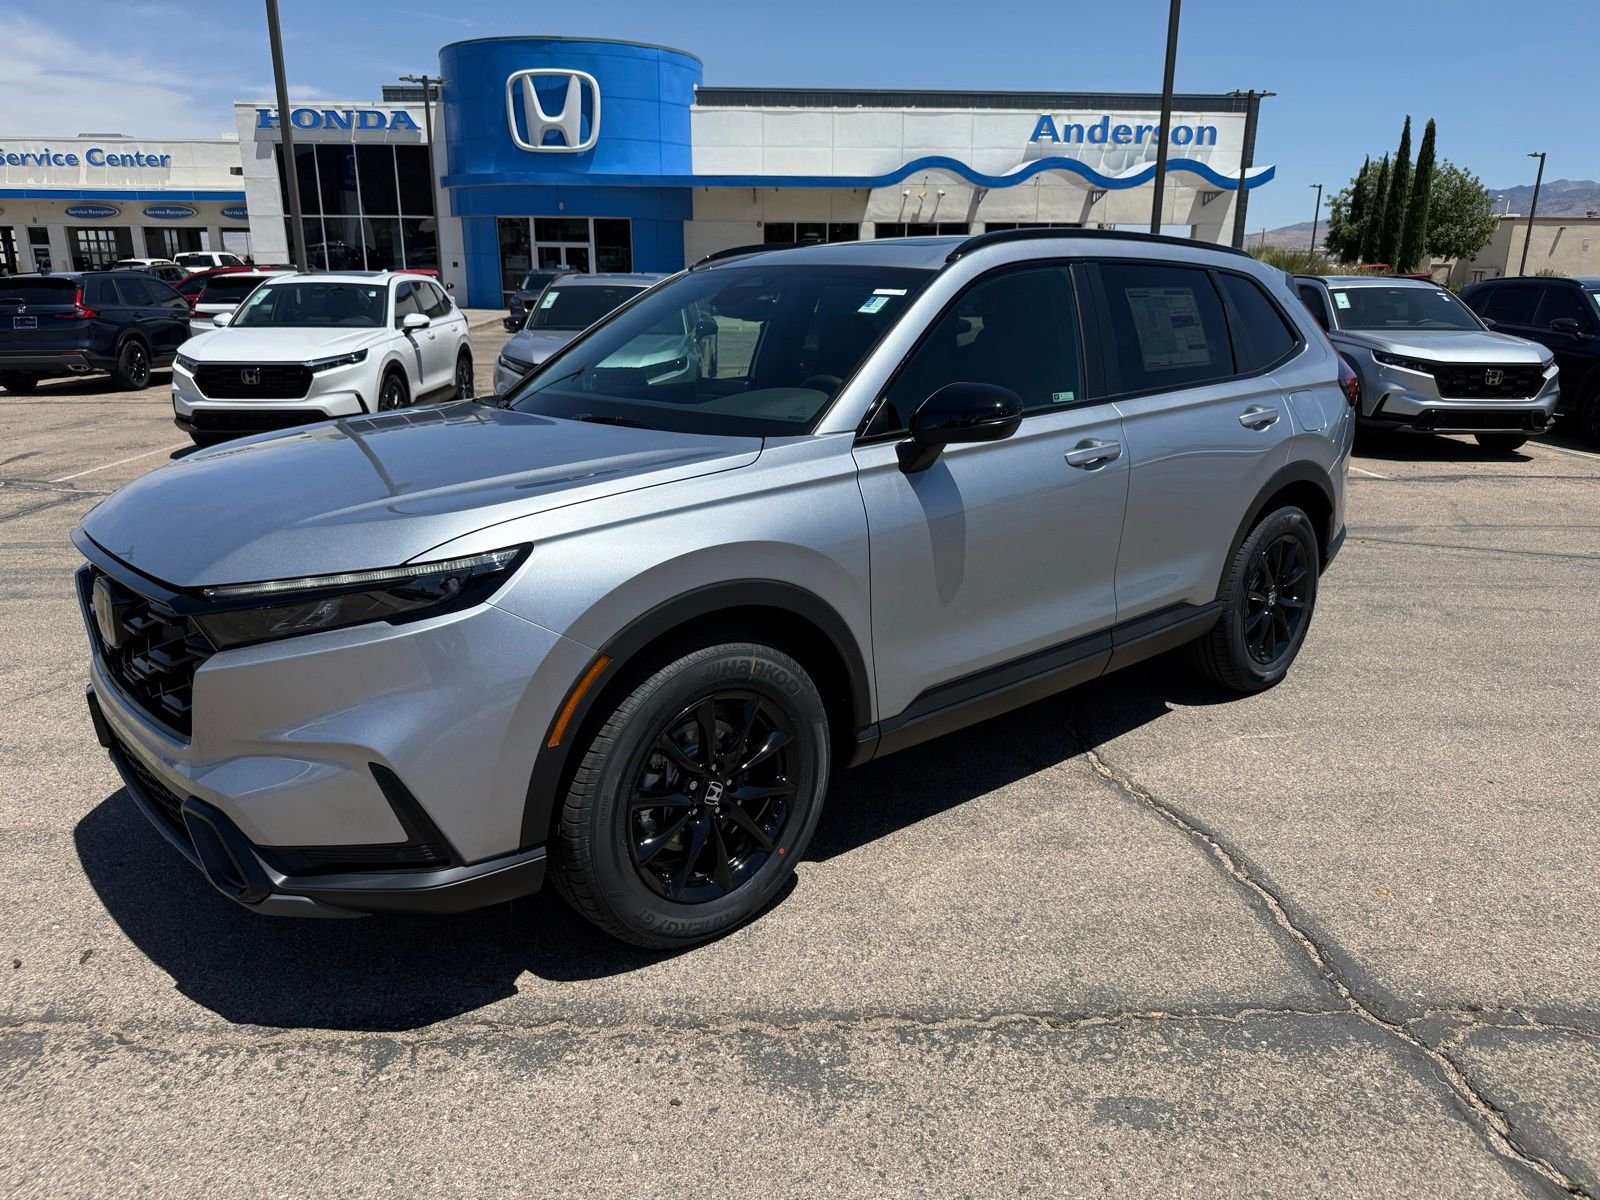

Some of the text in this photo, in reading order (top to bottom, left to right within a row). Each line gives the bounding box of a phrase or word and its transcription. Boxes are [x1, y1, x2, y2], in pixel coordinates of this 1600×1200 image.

[255, 108, 422, 130] HONDA
[85, 147, 171, 167] Center
[88, 208, 116, 217] Reception
[145, 208, 193, 217] Service Reception
